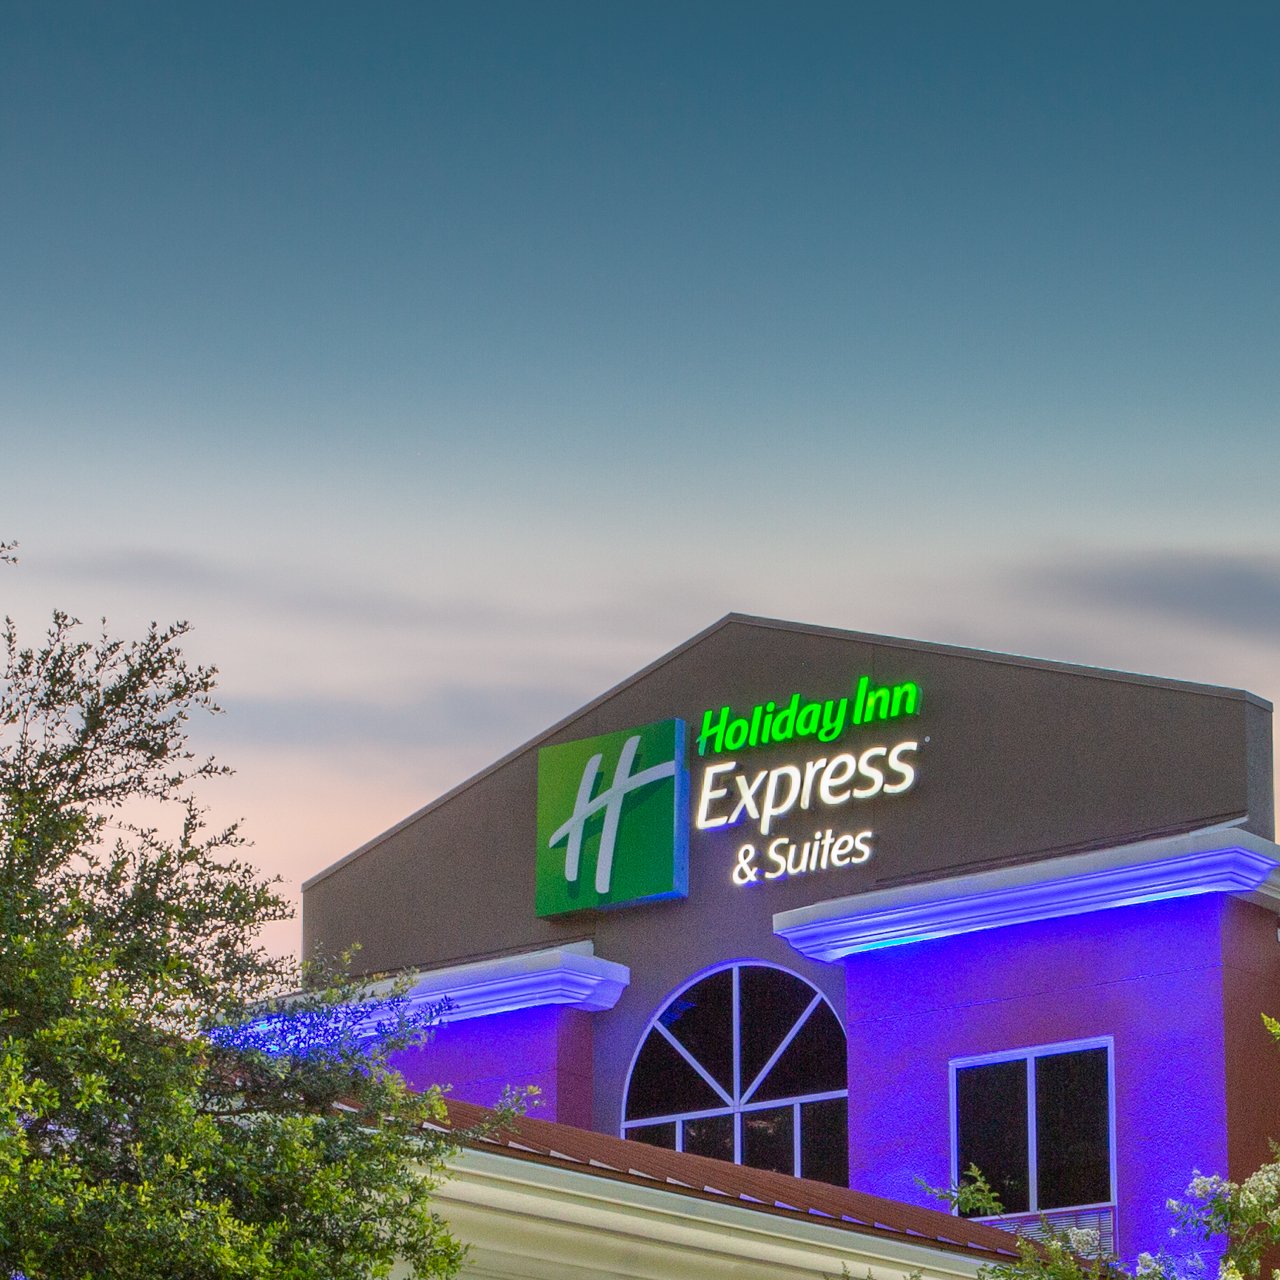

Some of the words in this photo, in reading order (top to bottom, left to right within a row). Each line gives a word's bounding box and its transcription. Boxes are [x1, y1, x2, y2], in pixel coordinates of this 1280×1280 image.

[696, 693, 848, 756] Holiday
[853, 676, 917, 725] Inn
[696, 741, 918, 835] Express
[731, 843, 759, 886] &
[765, 829, 873, 879] Suites
